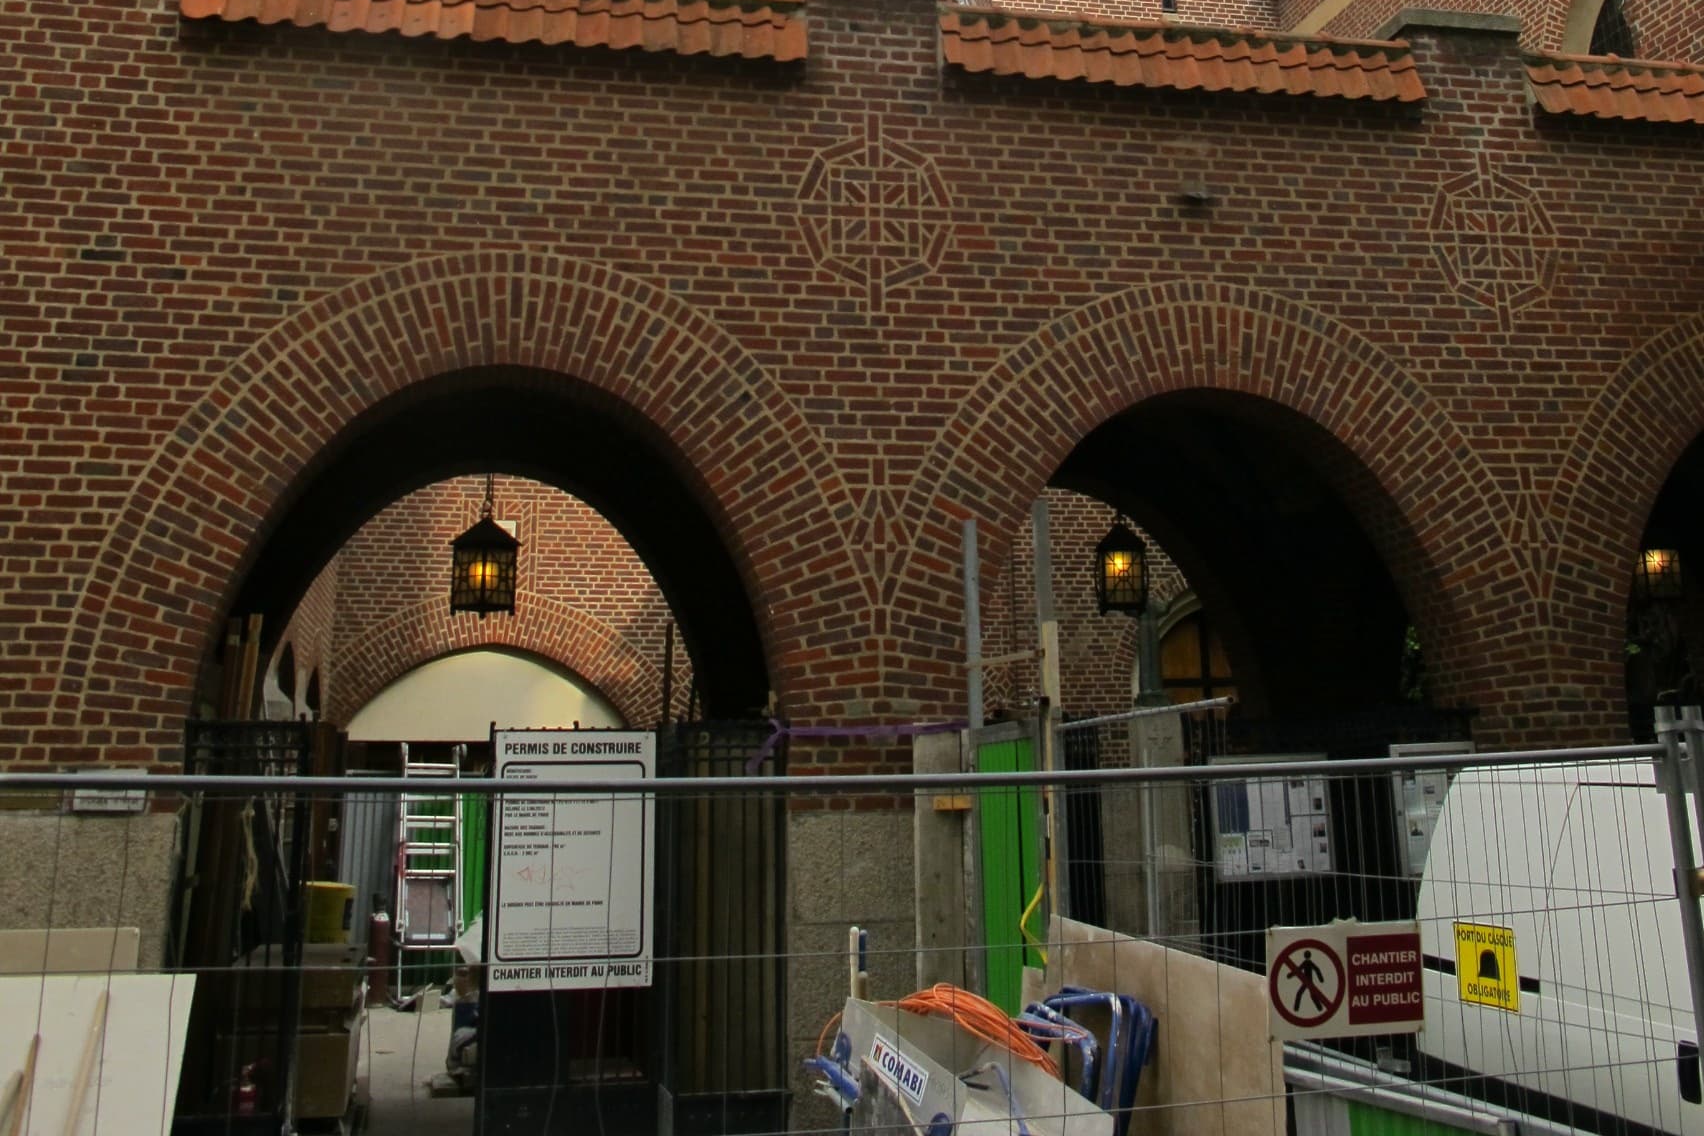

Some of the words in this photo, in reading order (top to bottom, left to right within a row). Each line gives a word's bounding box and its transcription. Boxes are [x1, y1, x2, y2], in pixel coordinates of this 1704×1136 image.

[504, 743, 550, 755] PERMIS
[553, 742, 568, 755] DE
[571, 742, 642, 755] CONSTRUIRE
[1457, 928, 1475, 943] PORT
[1476, 930, 1487, 944] DU
[1488, 932, 1513, 948] CASQUE
[1352, 950, 1418, 965] CHANTIER
[493, 968, 542, 980] CHANTIER
[545, 966, 588, 979] INTERDIT
[591, 965, 604, 977] AU
[607, 964, 642, 977] PUBLIC
[1356, 972, 1414, 986] INTERDIT
[1352, 994, 1369, 1007] AU
[1373, 992, 1421, 1006] PUBLIC
[1467, 983, 1511, 1002] OBLIGATOIRE
[882, 1051, 923, 1096] COMABI
